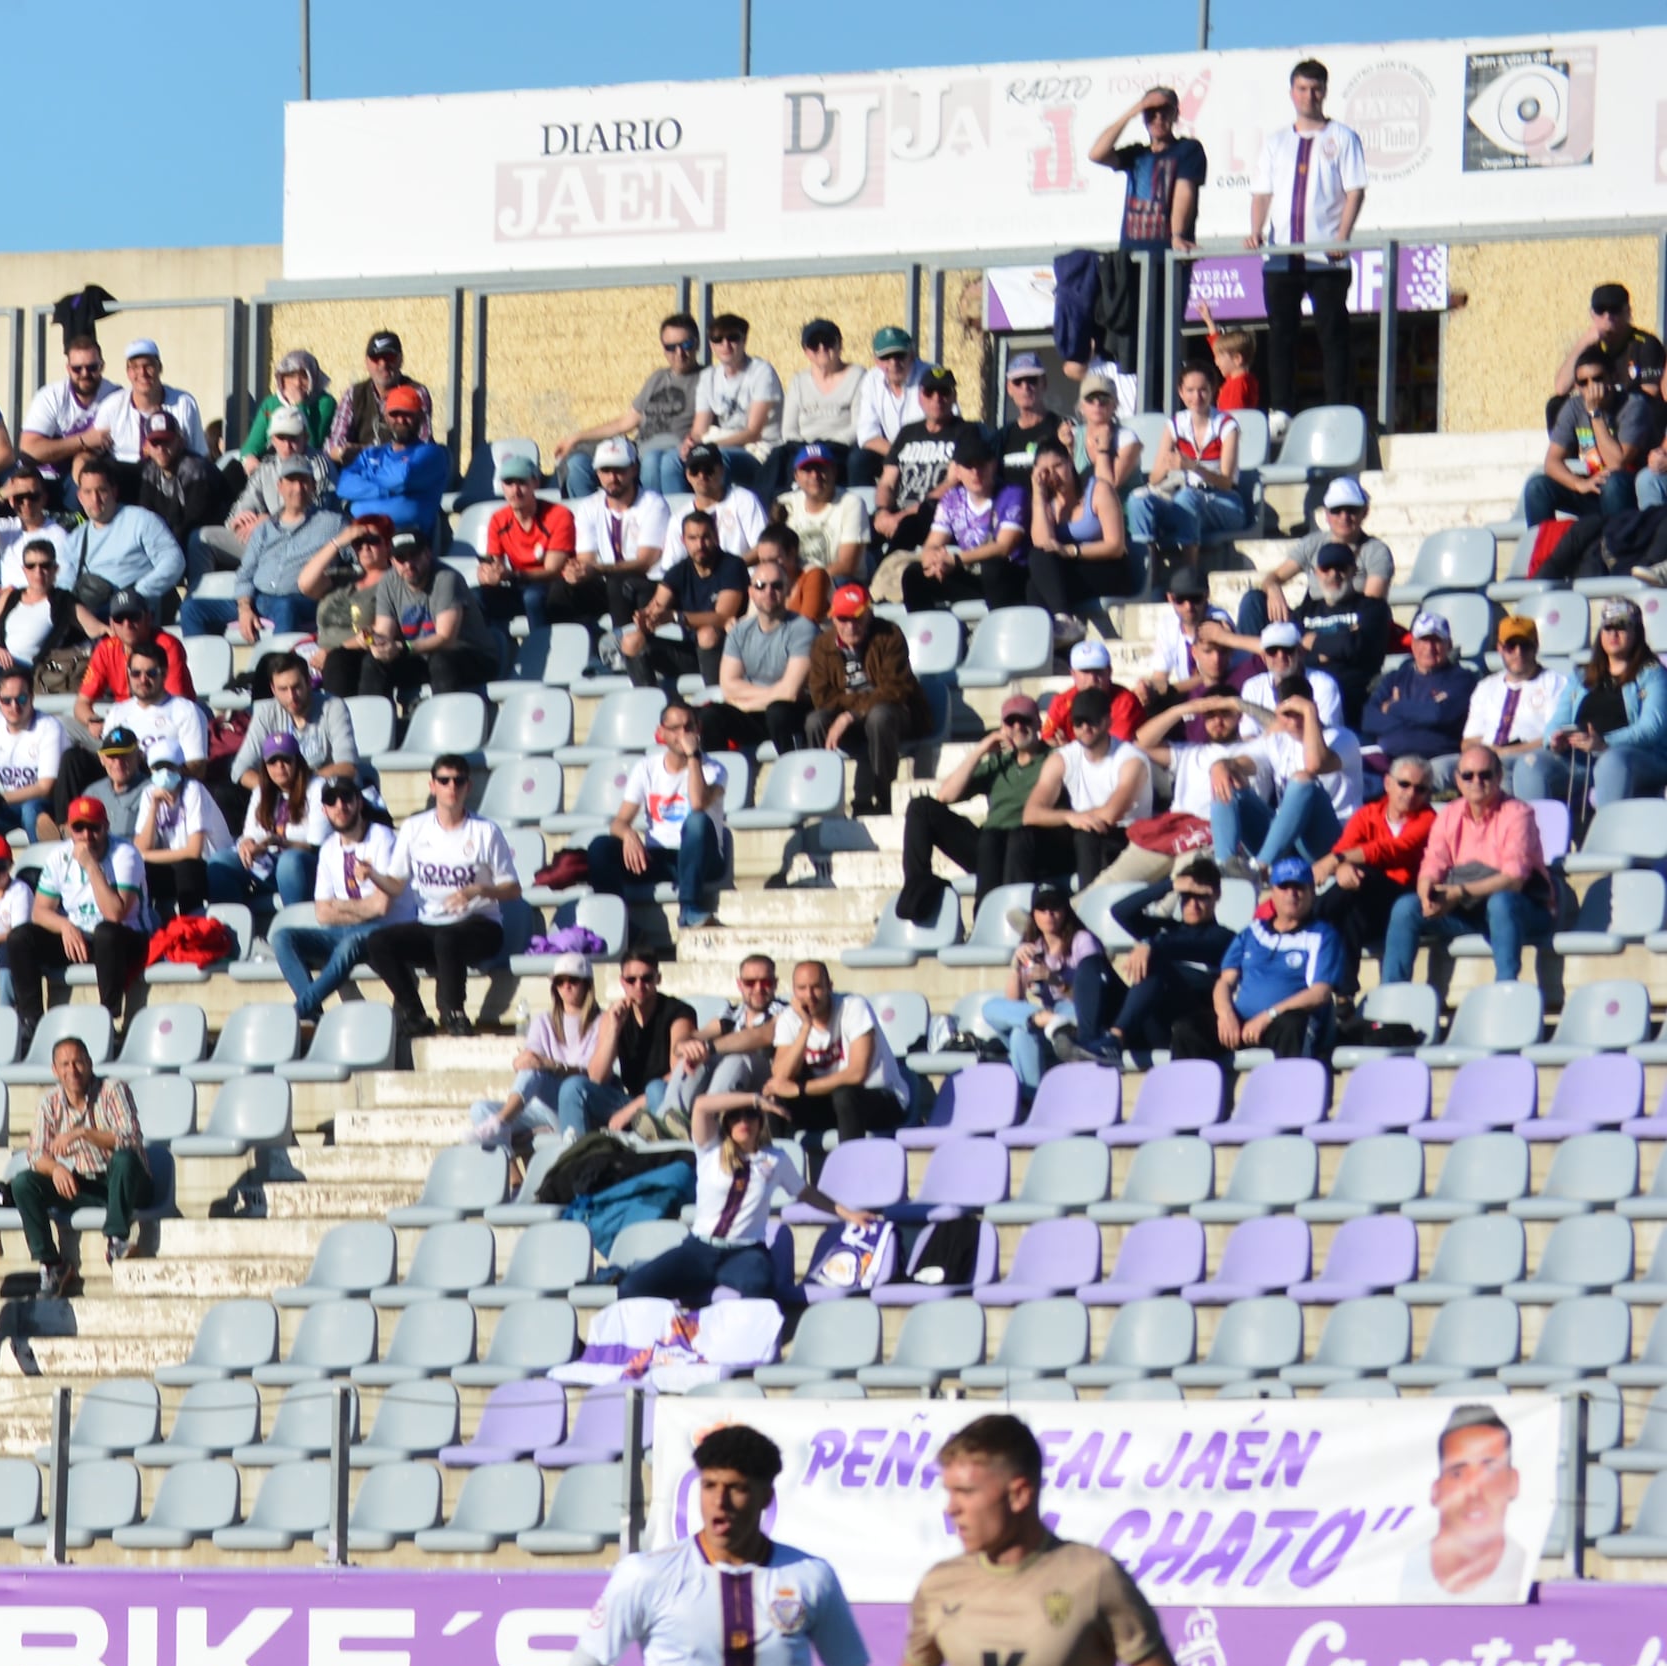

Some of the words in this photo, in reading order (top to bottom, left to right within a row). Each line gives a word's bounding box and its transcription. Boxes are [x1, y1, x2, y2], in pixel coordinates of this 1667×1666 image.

[1007, 77, 1092, 104] RADIO
[540, 117, 683, 156] DIARIO
[1193, 269, 1240, 283] VEZAS
[1189, 282, 1245, 300] TORIA
[1037, 1430, 1133, 1489] EAL
[1143, 1411, 1323, 1490] JAÉN
